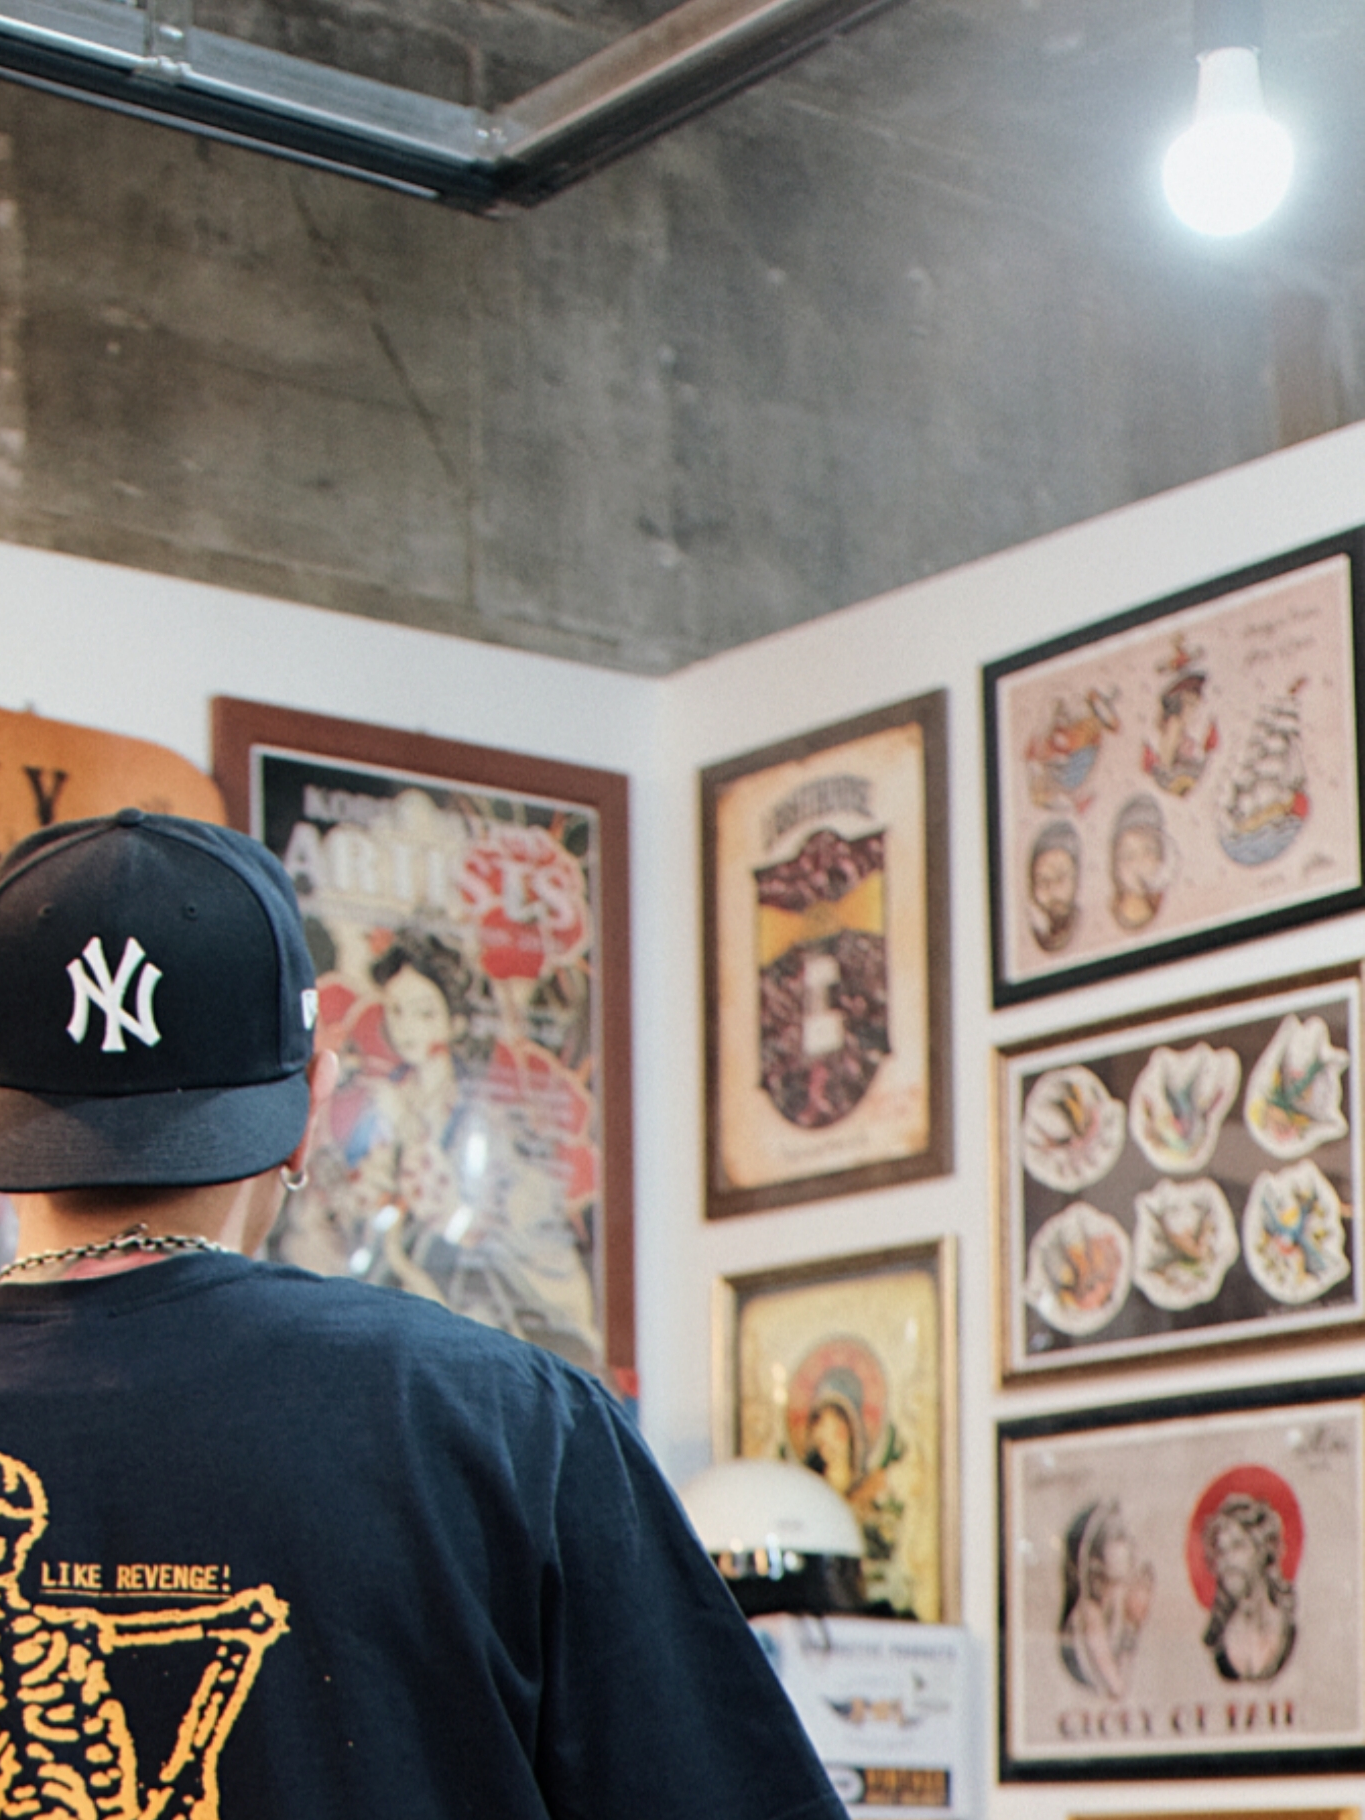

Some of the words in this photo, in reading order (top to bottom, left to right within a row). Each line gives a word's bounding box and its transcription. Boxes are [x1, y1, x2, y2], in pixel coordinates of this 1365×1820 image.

[66, 936, 163, 1052] NY
[41, 1562, 102, 1588] LIKE
[116, 1564, 231, 1592] REVENGE!
